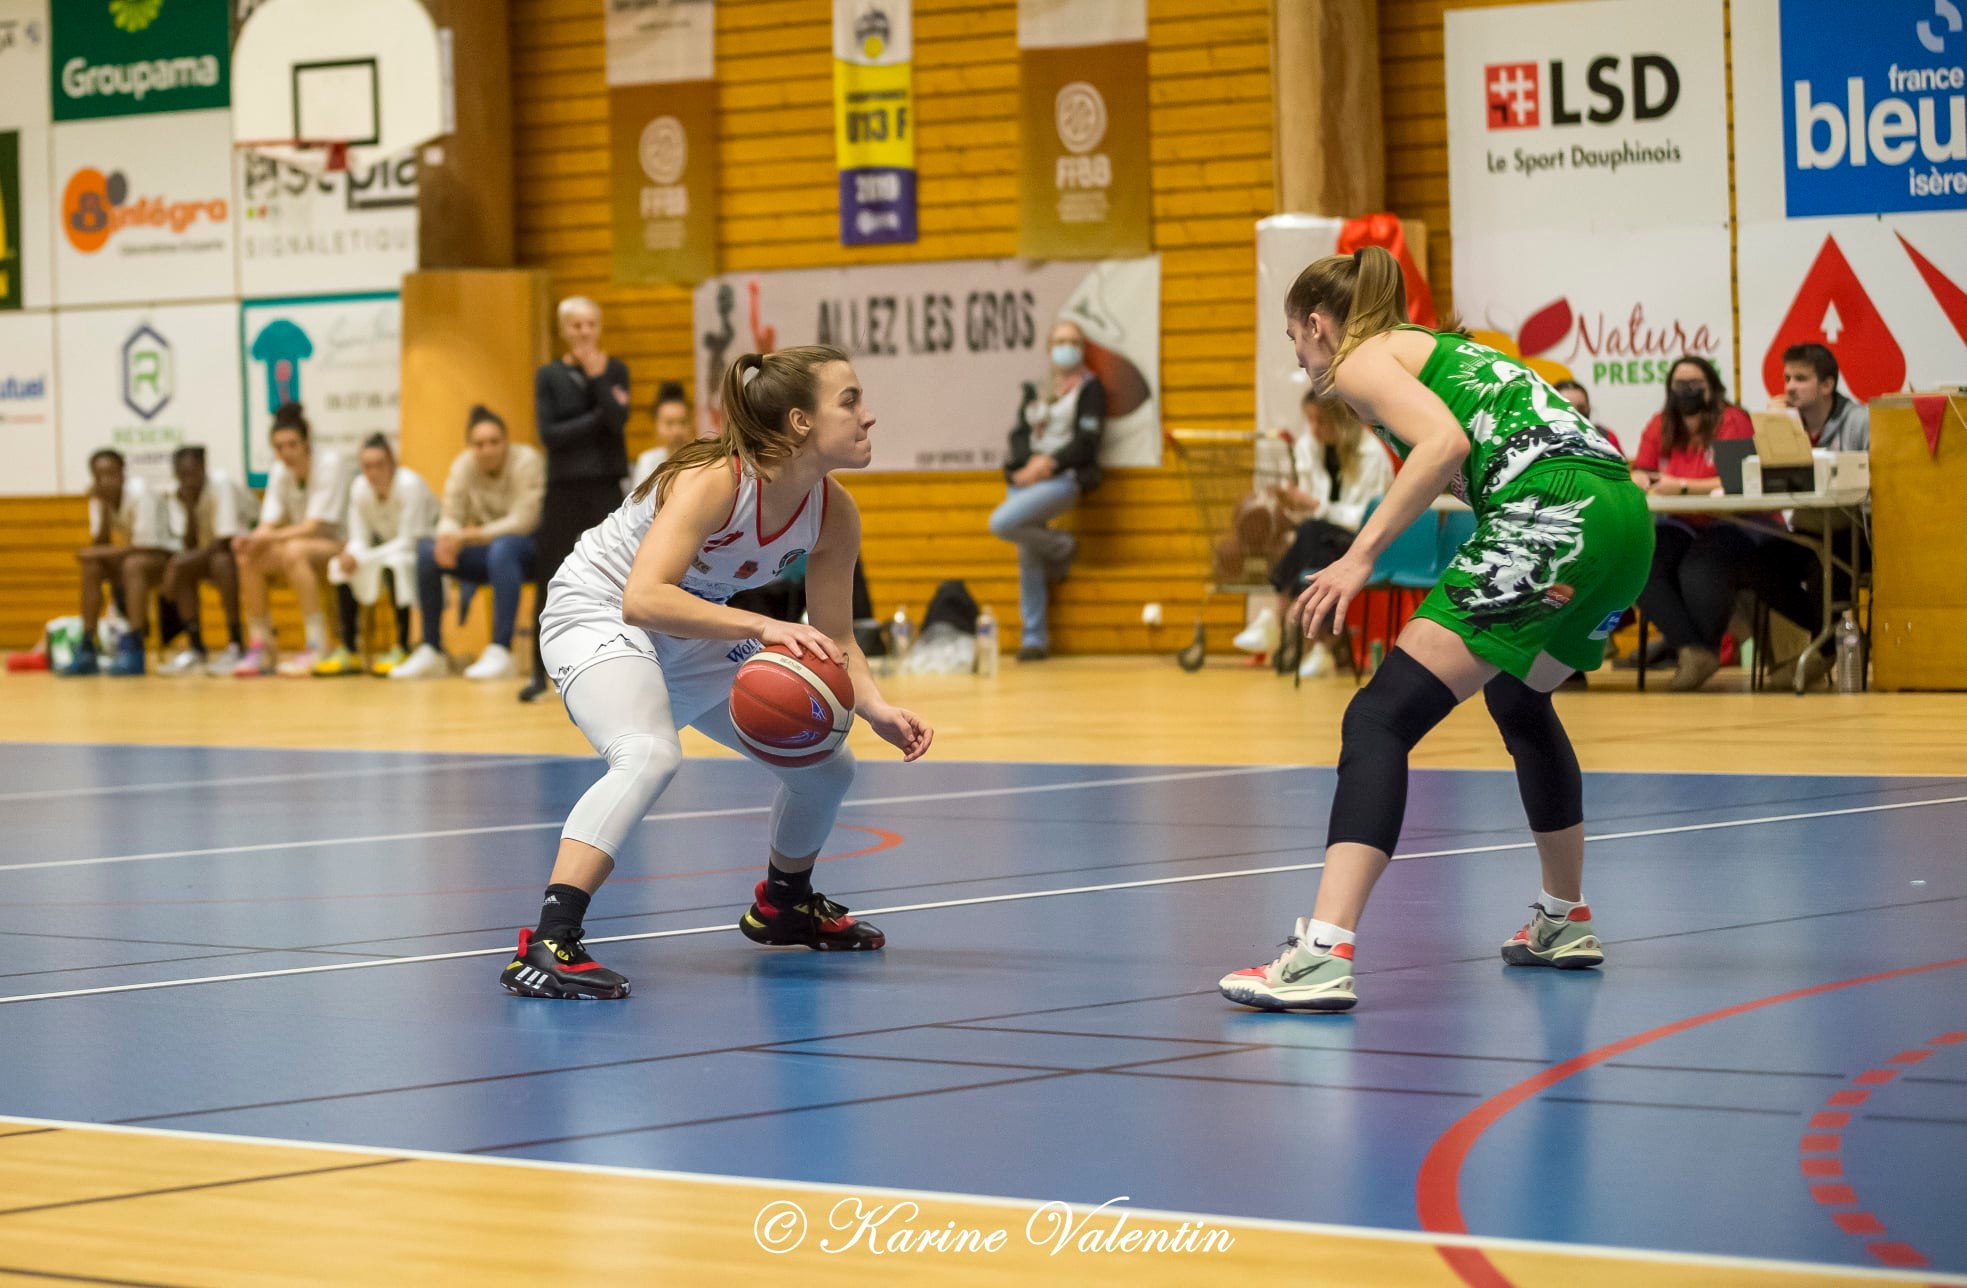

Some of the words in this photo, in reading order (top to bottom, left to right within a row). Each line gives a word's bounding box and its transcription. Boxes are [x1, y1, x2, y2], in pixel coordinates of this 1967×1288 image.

[62, 55, 219, 100] Groupama
[1550, 53, 1680, 127] LSD
[1888, 63, 1965, 93] france
[1794, 77, 1967, 170] bleu
[1487, 149, 1507, 173] Le
[1513, 147, 1565, 177] Sport
[1570, 139, 1681, 173] Dauphinois
[1909, 165, 1967, 196] isère
[817, 297, 896, 357] ALLEZ
[907, 293, 954, 353] LES
[966, 287, 1036, 351] GROS
[1566, 302, 1720, 362] Natura
